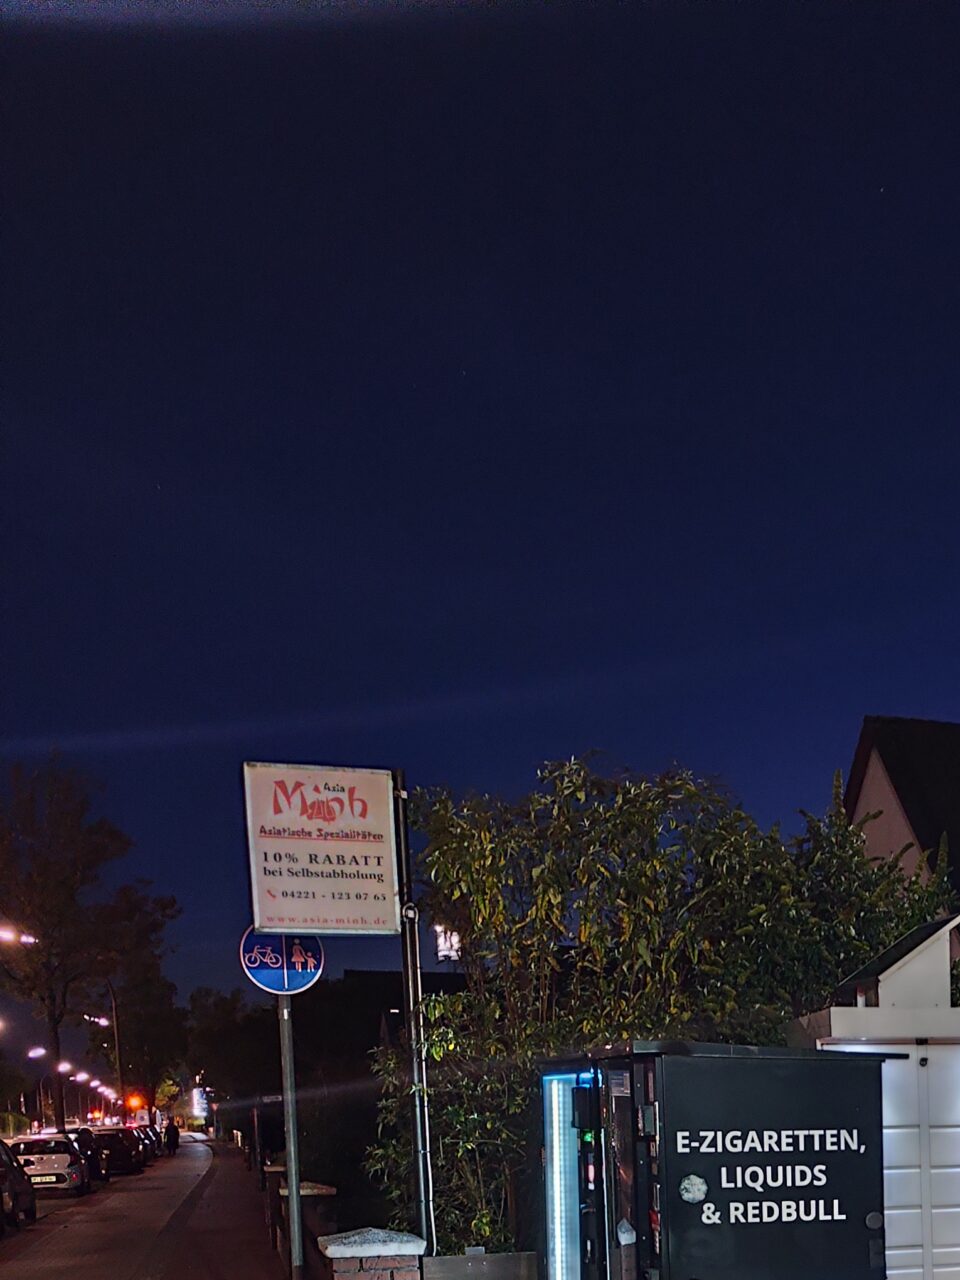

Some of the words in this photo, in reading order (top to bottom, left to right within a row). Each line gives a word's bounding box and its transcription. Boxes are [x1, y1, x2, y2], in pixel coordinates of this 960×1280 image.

[323, 781, 346, 793] Asia
[259, 824, 313, 838] Asiatische
[316, 828, 384, 841] Spezialitäten
[263, 851, 299, 864] 10%
[308, 853, 384, 867] RABATT
[263, 866, 283, 877] bei
[286, 867, 384, 884] Selbstabholung
[281, 890, 317, 900] 04221
[355, 892, 369, 901] 07
[676, 1129, 866, 1154] E-ZIGARETTEN,
[720, 1165, 827, 1192] LIQUIDS
[701, 1202, 721, 1224] &
[729, 1199, 847, 1224] REDBULL
